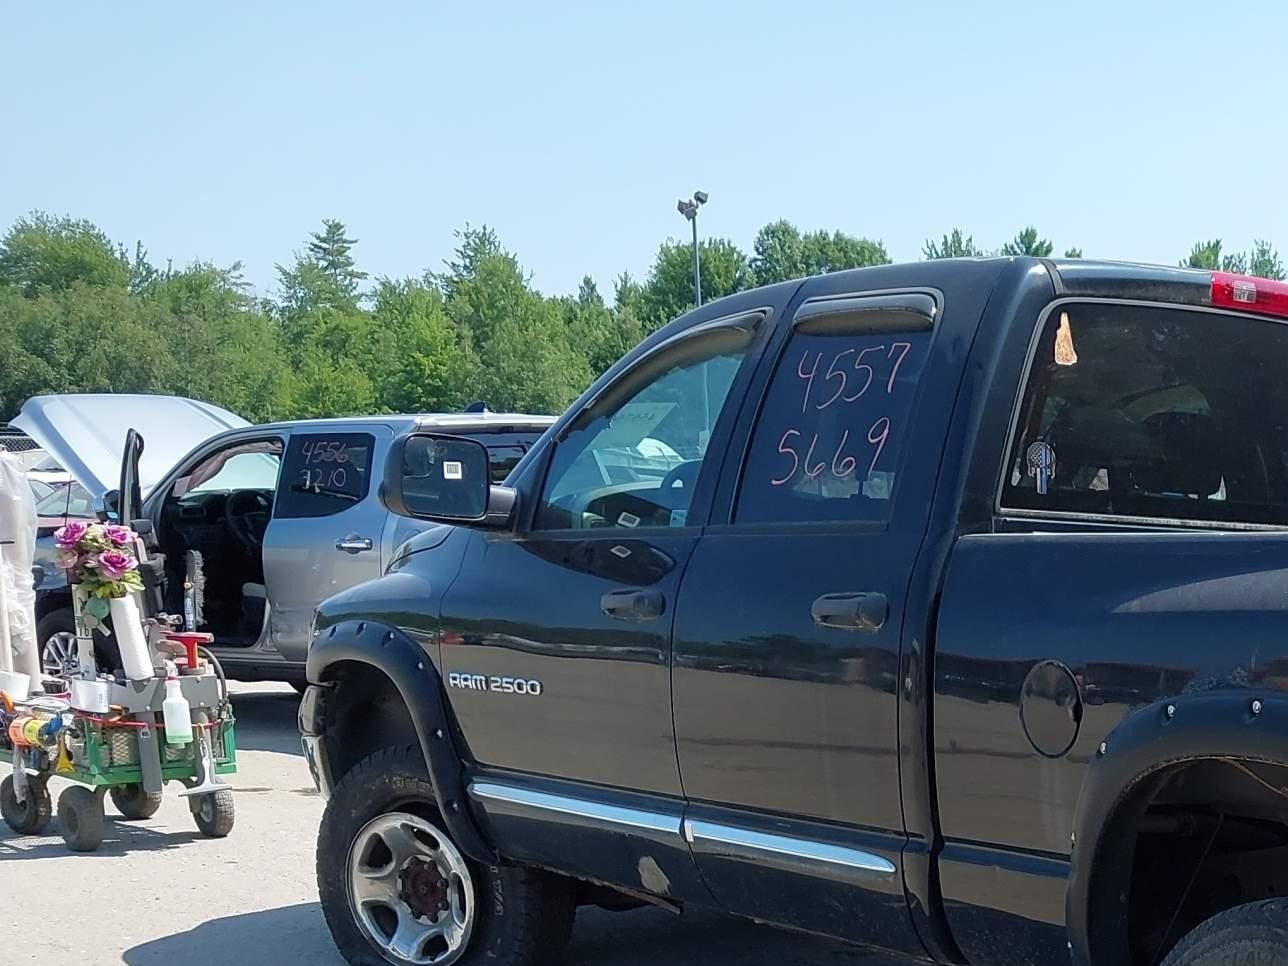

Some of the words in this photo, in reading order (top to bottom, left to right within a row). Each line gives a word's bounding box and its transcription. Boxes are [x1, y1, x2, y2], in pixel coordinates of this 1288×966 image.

[797, 342, 912, 413] 4557
[302, 441, 349, 465] 4556
[771, 417, 889, 485] 5669
[449, 672, 487, 691] RAM
[490, 676, 542, 695] 2500
